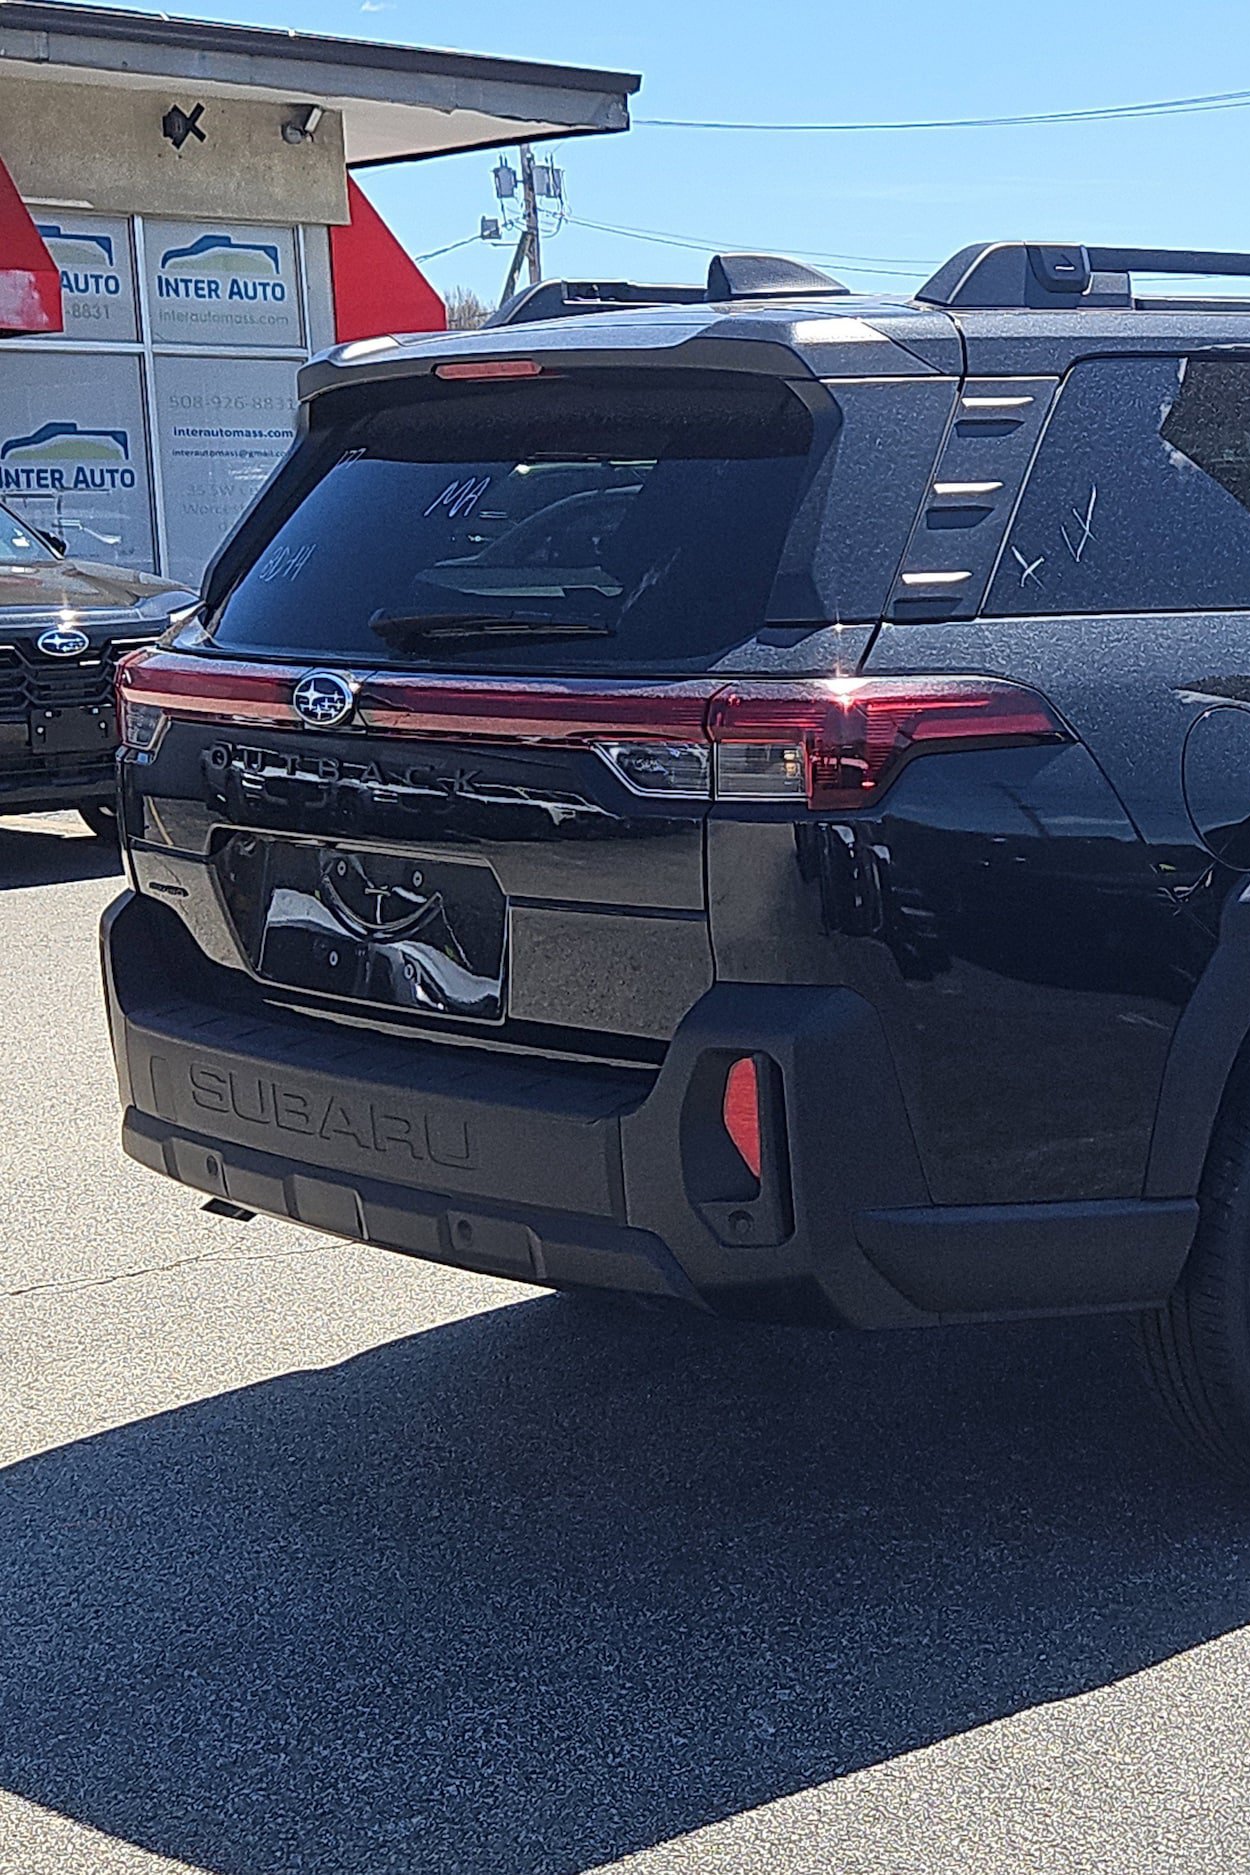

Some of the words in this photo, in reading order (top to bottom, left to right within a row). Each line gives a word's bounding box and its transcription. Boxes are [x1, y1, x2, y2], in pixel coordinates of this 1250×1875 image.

[60, 271, 120, 295] AUTO
[157, 274, 221, 299] INTER
[228, 278, 285, 302] AUTO
[65, 302, 110, 320] -8831
[159, 308, 289, 326] interautomass.com
[172, 448, 288, 459] interautomass@gmail.co
[0, 465, 65, 489] INTER
[73, 466, 135, 489] AUTO
[210, 742, 484, 793] OUTBACK
[189, 1060, 476, 1171] SUBARU
